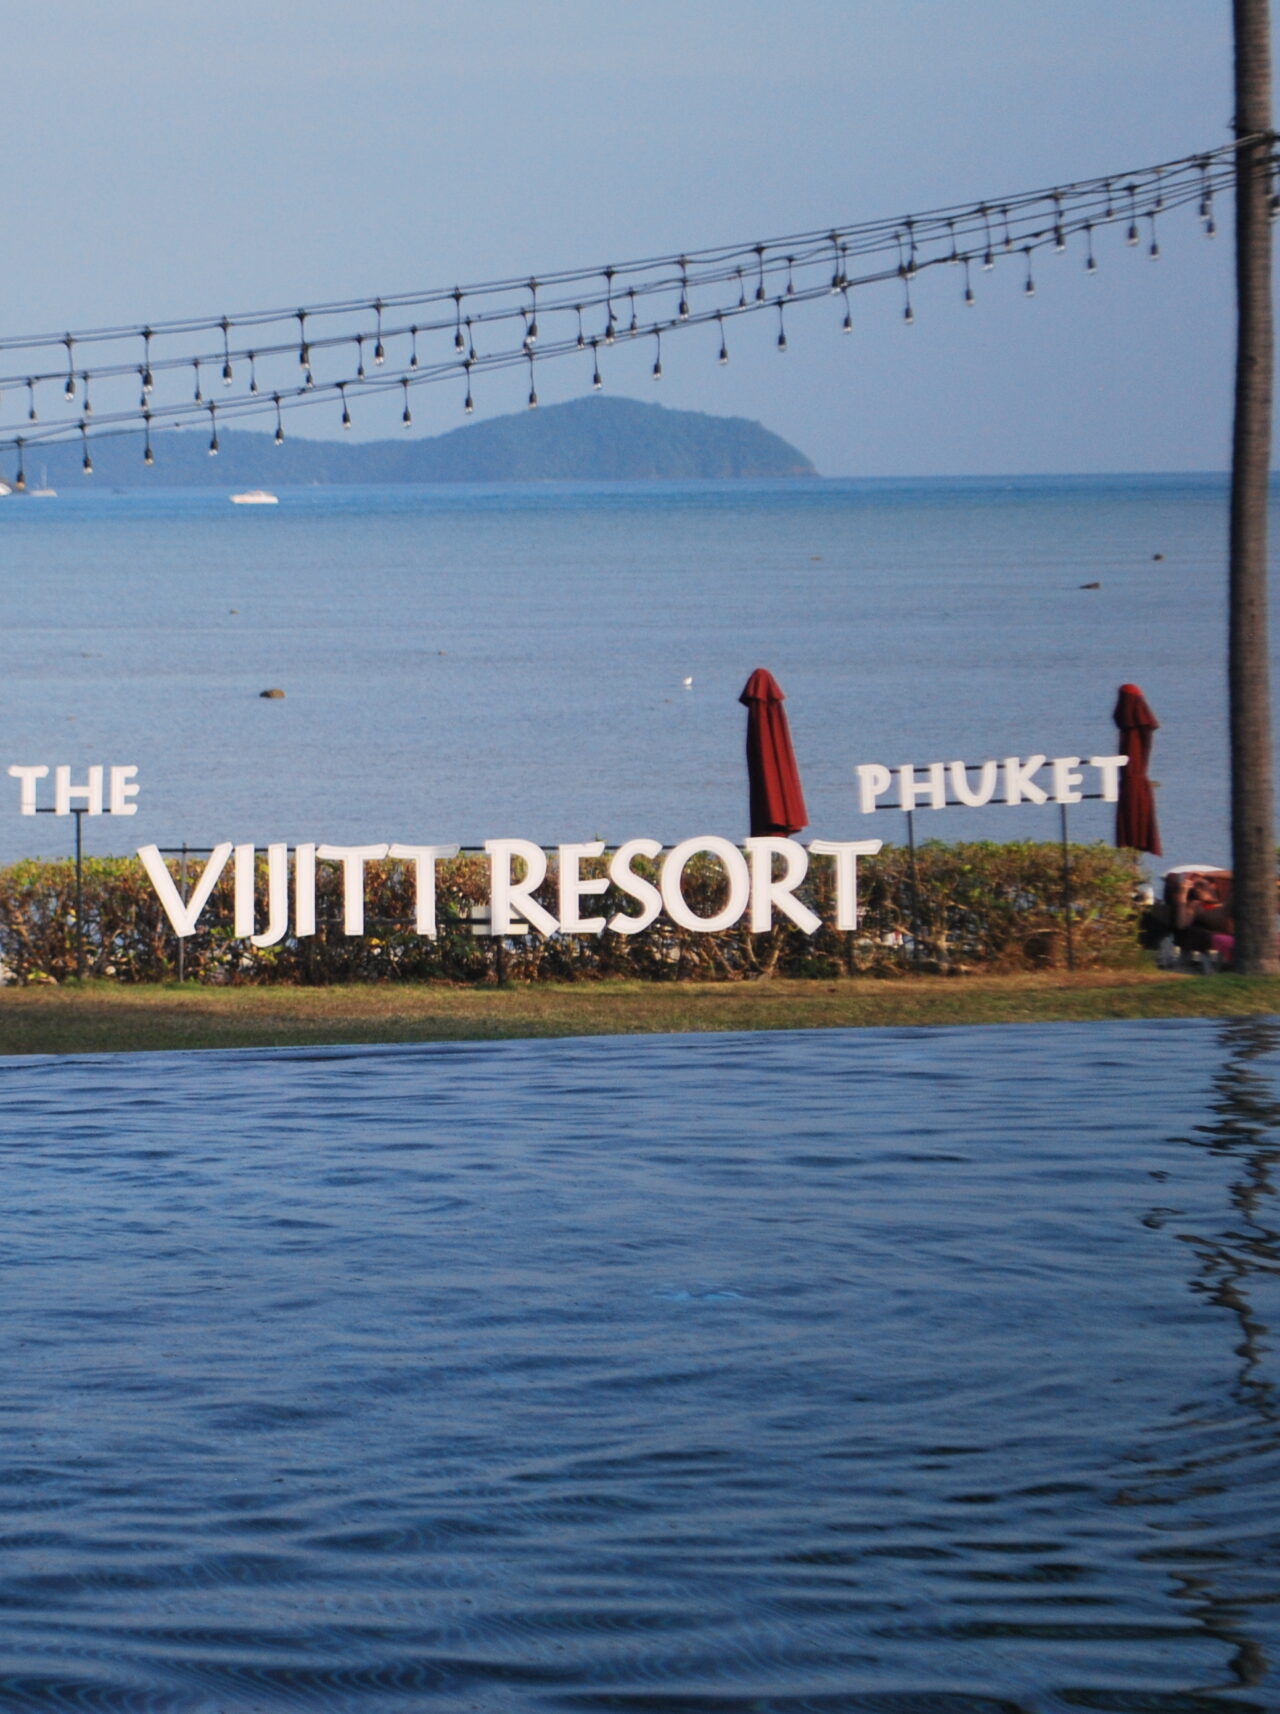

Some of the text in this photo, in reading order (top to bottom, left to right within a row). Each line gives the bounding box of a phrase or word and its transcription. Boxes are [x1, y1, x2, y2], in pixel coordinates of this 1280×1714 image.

[7, 764, 141, 816] THE
[855, 754, 1129, 814] PHUKET
[136, 836, 883, 948] VIJITT RESORT
